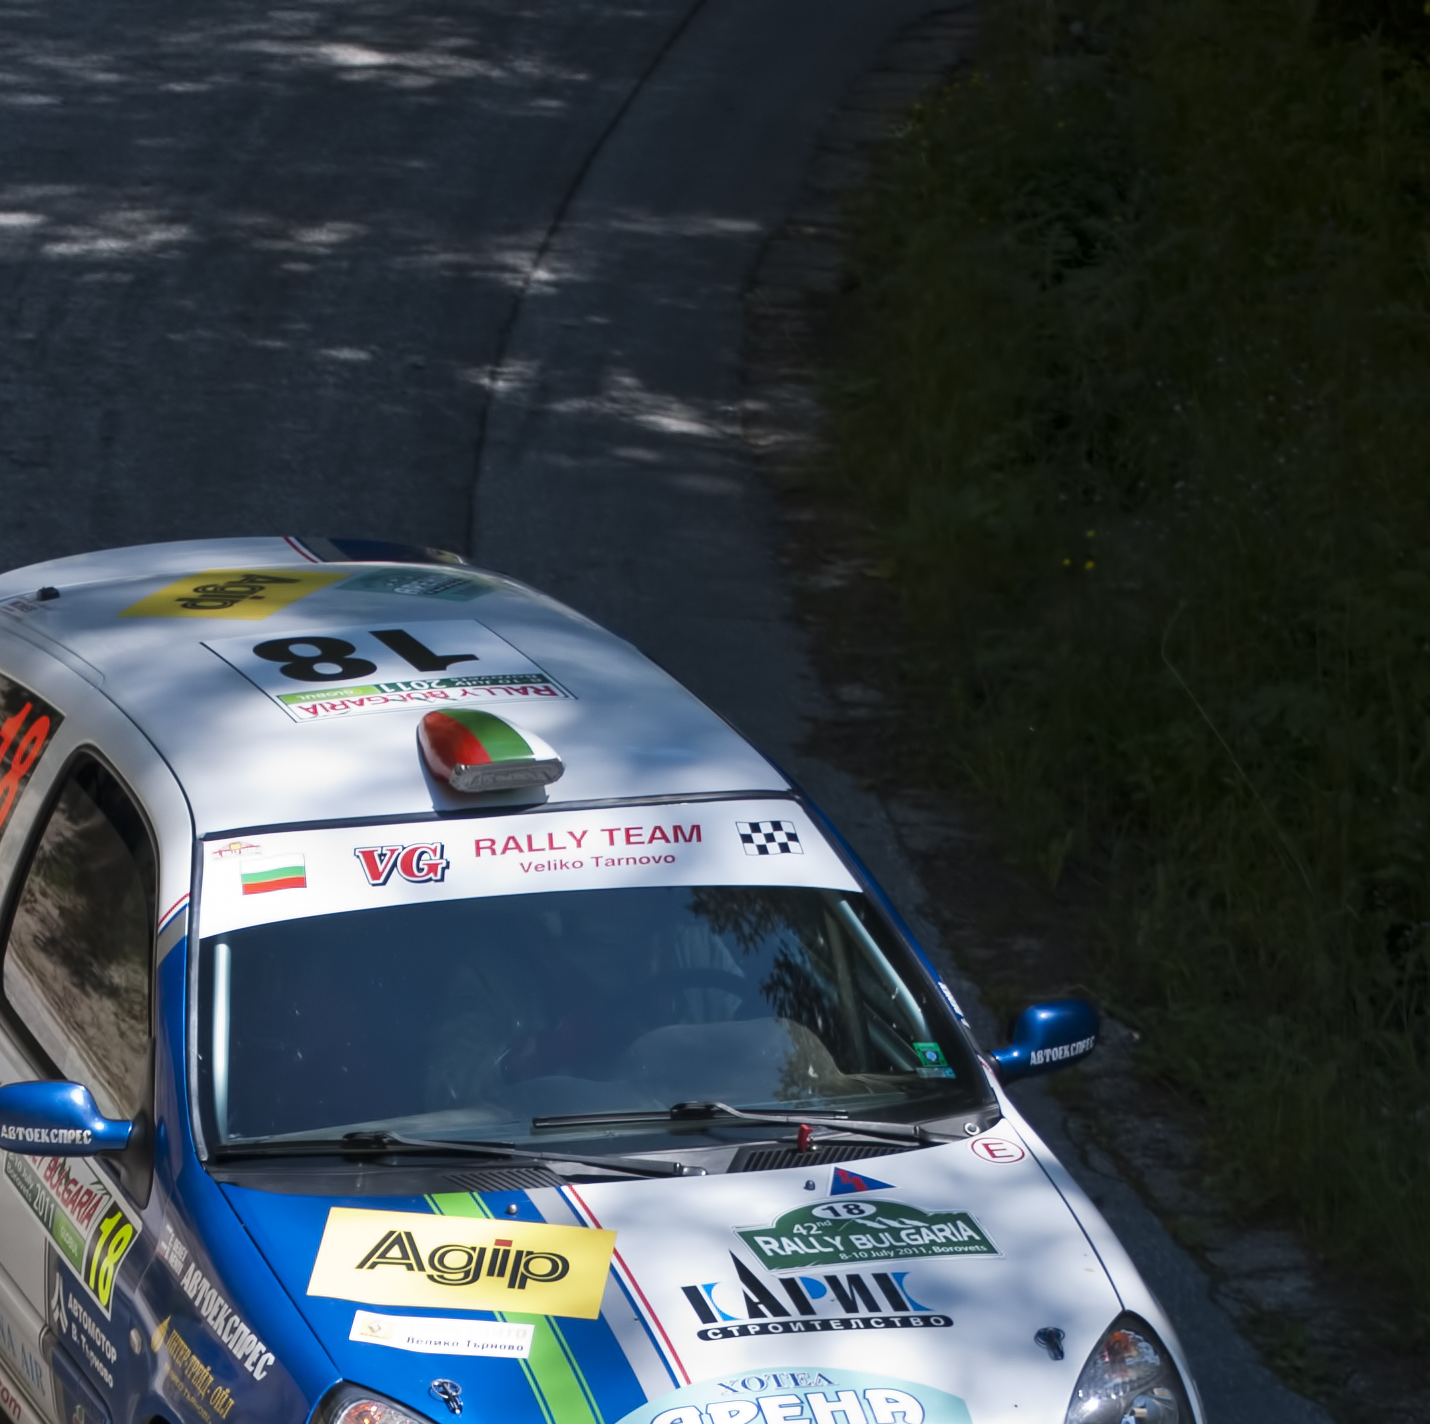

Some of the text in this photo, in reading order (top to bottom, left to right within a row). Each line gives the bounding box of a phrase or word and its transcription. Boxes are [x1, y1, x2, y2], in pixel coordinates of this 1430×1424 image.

[179, 572, 303, 612] Agip
[252, 628, 480, 682] 18
[297, 684, 559, 717] RALLY BULGARIA
[378, 679, 447, 692] 2011
[474, 823, 703, 858] RALLY TEAM
[354, 842, 449, 886] VG
[519, 851, 676, 873] Veliko Tarnovo
[1029, 1035, 1095, 1067] АВТОЕКСПРЕС
[0, 1123, 92, 1146] АВТОЕКСПРЕС
[982, 1142, 1015, 1159] E
[33, 1183, 55, 1229] 2011
[43, 1156, 104, 1230] BULGARIA
[821, 1201, 864, 1218] 18
[753, 1220, 982, 1256] RALLY BULGARIA
[792, 1219, 833, 1236] 42nd
[89, 1211, 133, 1307] 18
[355, 1230, 570, 1290] Agip
[839, 1250, 868, 1260] 8-10
[870, 1248, 895, 1259] July
[932, 1244, 988, 1254] Borovets
[680, 1248, 935, 1325] КАРИК
[68, 1292, 117, 1364] АВТОМОТОР
[180, 1262, 276, 1381] АВТОЕКСПРЕС
[706, 1314, 947, 1340] СТРОИТЕЛСТВО
[406, 1336, 524, 1352] Велико Търново
[716, 1371, 840, 1395] ХОТЕЛ
